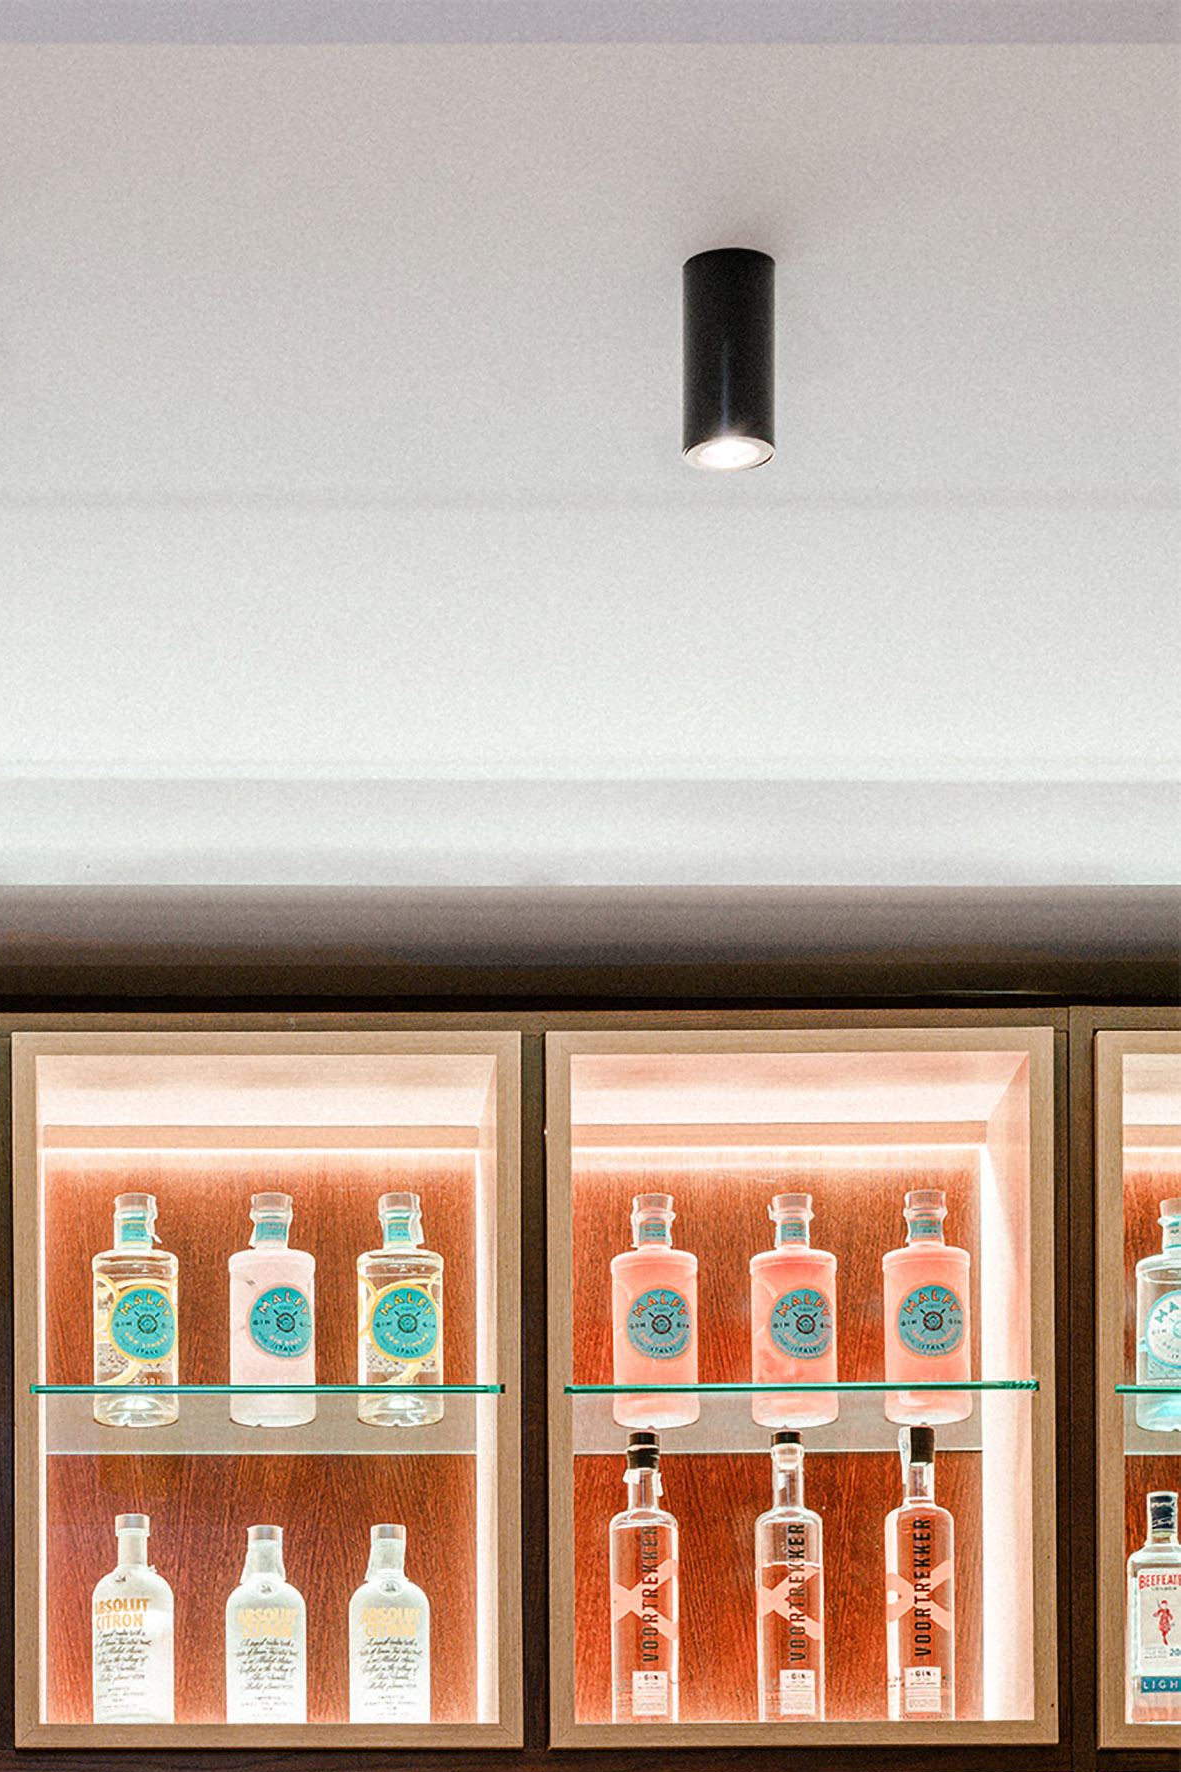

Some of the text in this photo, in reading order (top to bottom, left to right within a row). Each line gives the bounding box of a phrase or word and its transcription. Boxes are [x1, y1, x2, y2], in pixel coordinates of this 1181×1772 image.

[118, 1293, 171, 1316] MALFY
[257, 1291, 310, 1315] MALFY
[379, 1293, 434, 1316] MALFY
[632, 1293, 688, 1318] MALFY
[776, 1293, 831, 1317] MALFY
[904, 1289, 960, 1315] MALFY
[788, 1524, 806, 1662] VOORTREKKER
[913, 1518, 932, 1657] VOORTREKKER
[1139, 1574, 1181, 1589] BEEFEATE
[641, 1526, 659, 1662] VOORTREKKER
[97, 1613, 144, 1630] CITRON
[237, 1607, 297, 1625] ABSOLUT
[360, 1607, 421, 1625] ABSOLUT
[241, 1624, 293, 1639] CITRON
[365, 1623, 416, 1638] CITRON
[1143, 1680, 1178, 1690] LIGH
